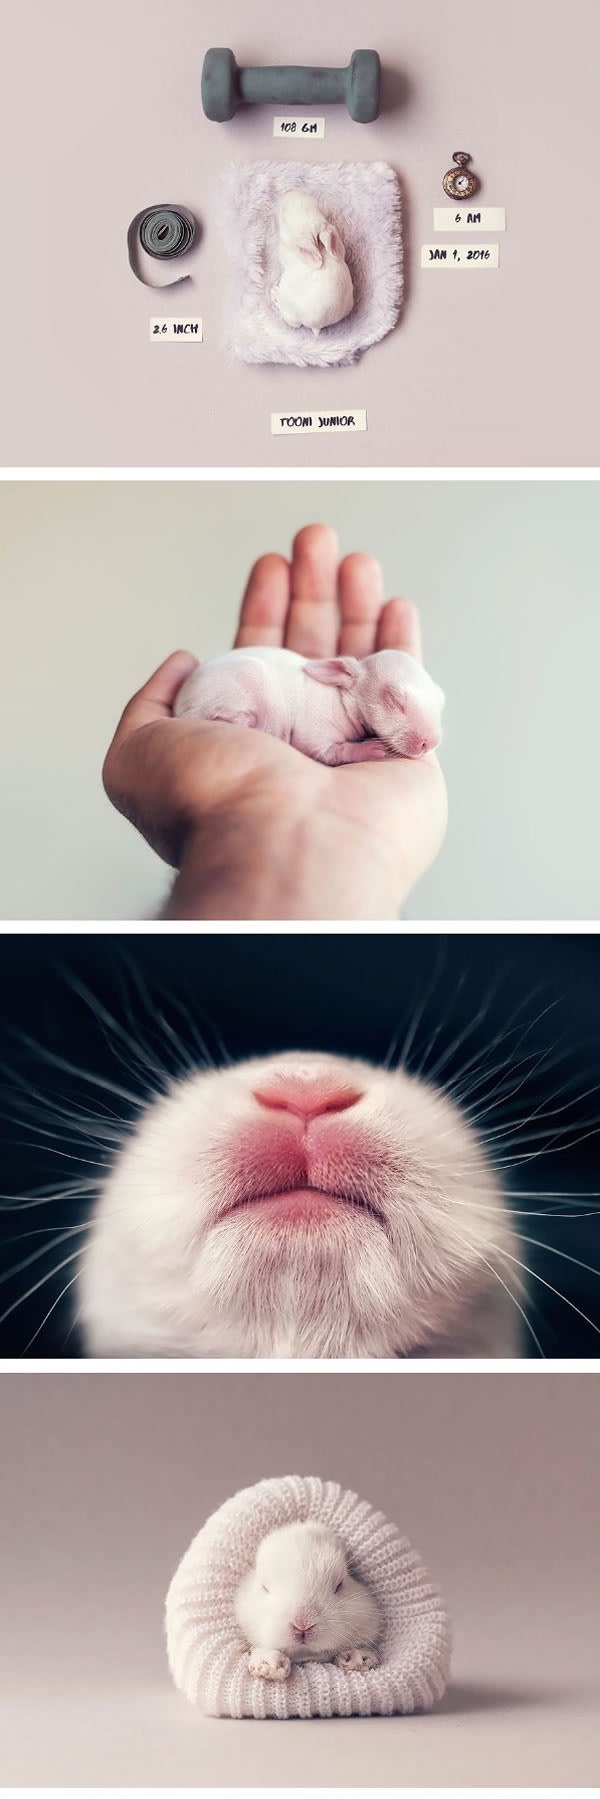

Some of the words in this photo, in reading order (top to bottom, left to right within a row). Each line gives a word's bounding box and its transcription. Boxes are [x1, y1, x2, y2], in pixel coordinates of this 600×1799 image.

[280, 122, 297, 133] 108
[301, 122, 318, 133] GM
[455, 213, 462, 223] 6
[467, 212, 481, 224] AM
[429, 249, 447, 261] JAN
[452, 249, 461, 262] 1,
[466, 249, 491, 260] 2016
[152, 323, 168, 335] 2.6
[173, 323, 199, 334] INCH
[280, 416, 313, 428] TOONI
[318, 415, 356, 428] JUNIOR
